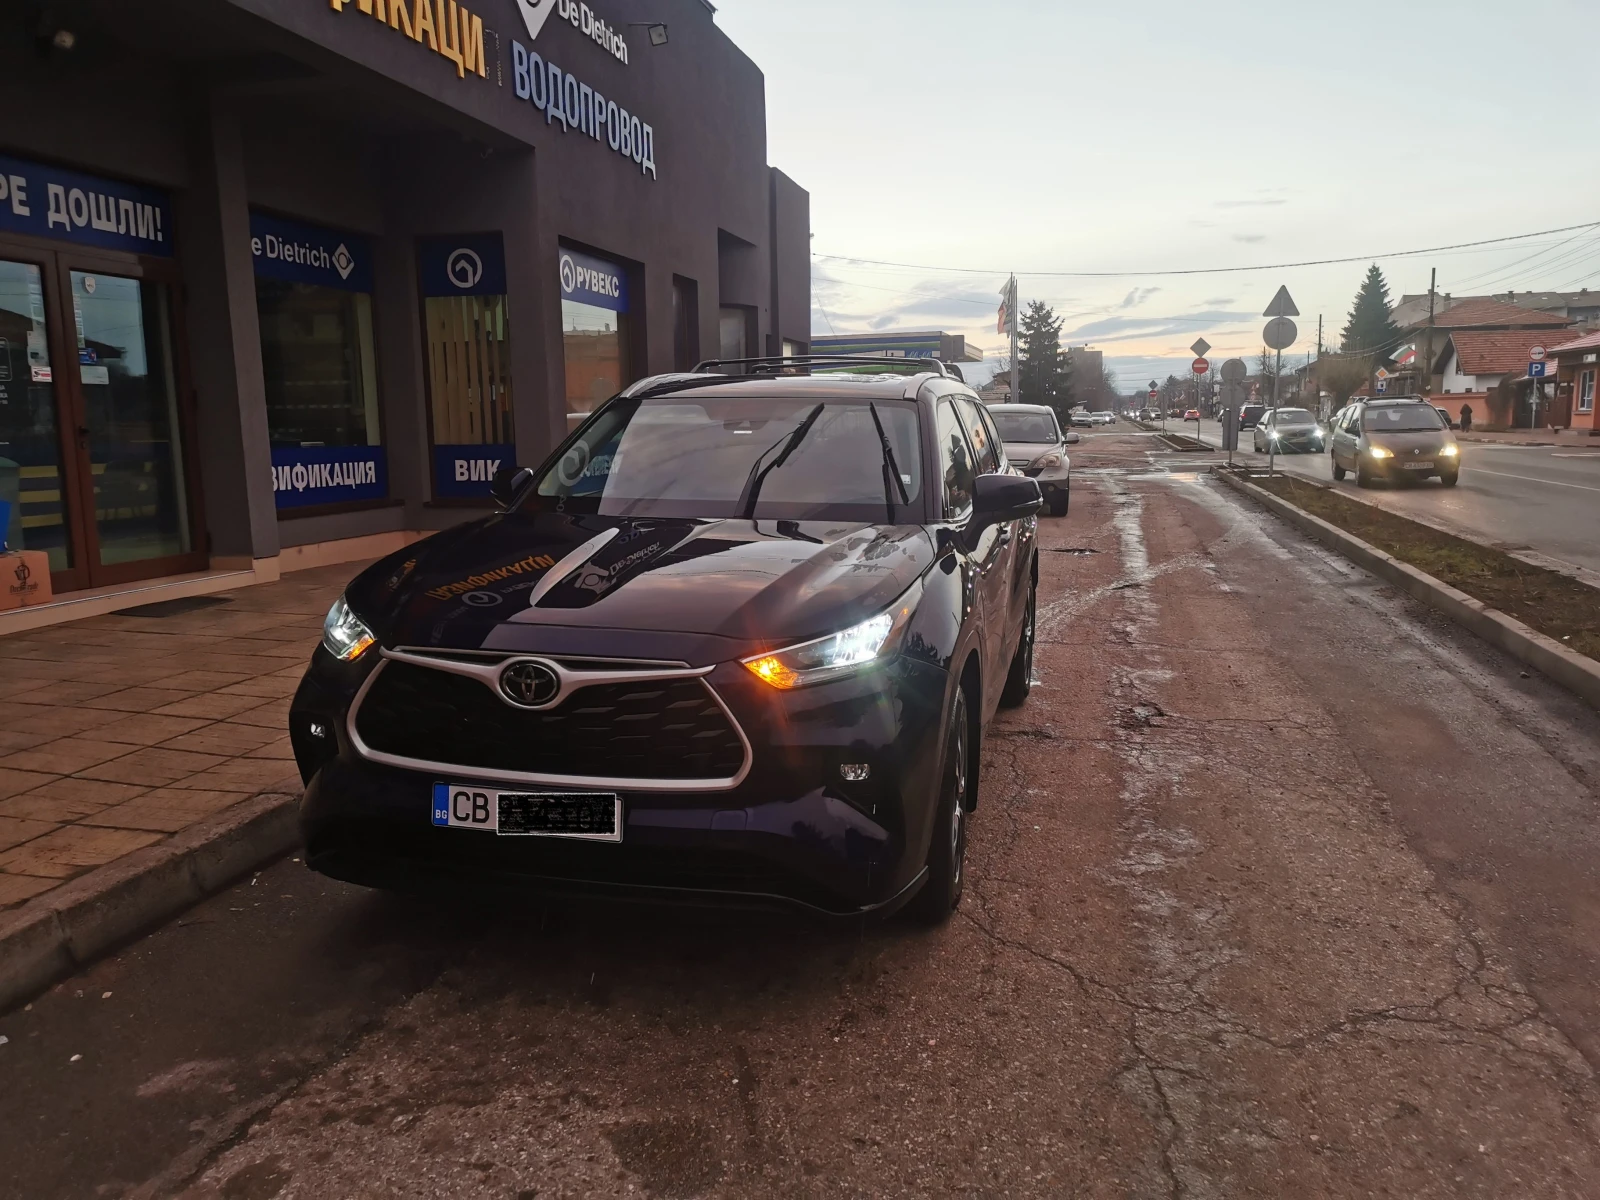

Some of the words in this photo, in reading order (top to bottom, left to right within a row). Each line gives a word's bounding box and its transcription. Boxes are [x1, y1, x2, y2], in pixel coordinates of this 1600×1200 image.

[330, 0, 487, 79] КАЦИ
[580, 1, 629, 65] Dietrich
[513, 39, 656, 181] ВОДОПРОВОД
[47, 182, 163, 242] ДОШЛИ!
[265, 234, 330, 269] Dietrich
[576, 265, 620, 298] РУВЕКС
[1532, 363, 1541, 375] P
[454, 459, 502, 482] ВИК
[435, 809, 448, 820] BG
[452, 791, 490, 824] CB
